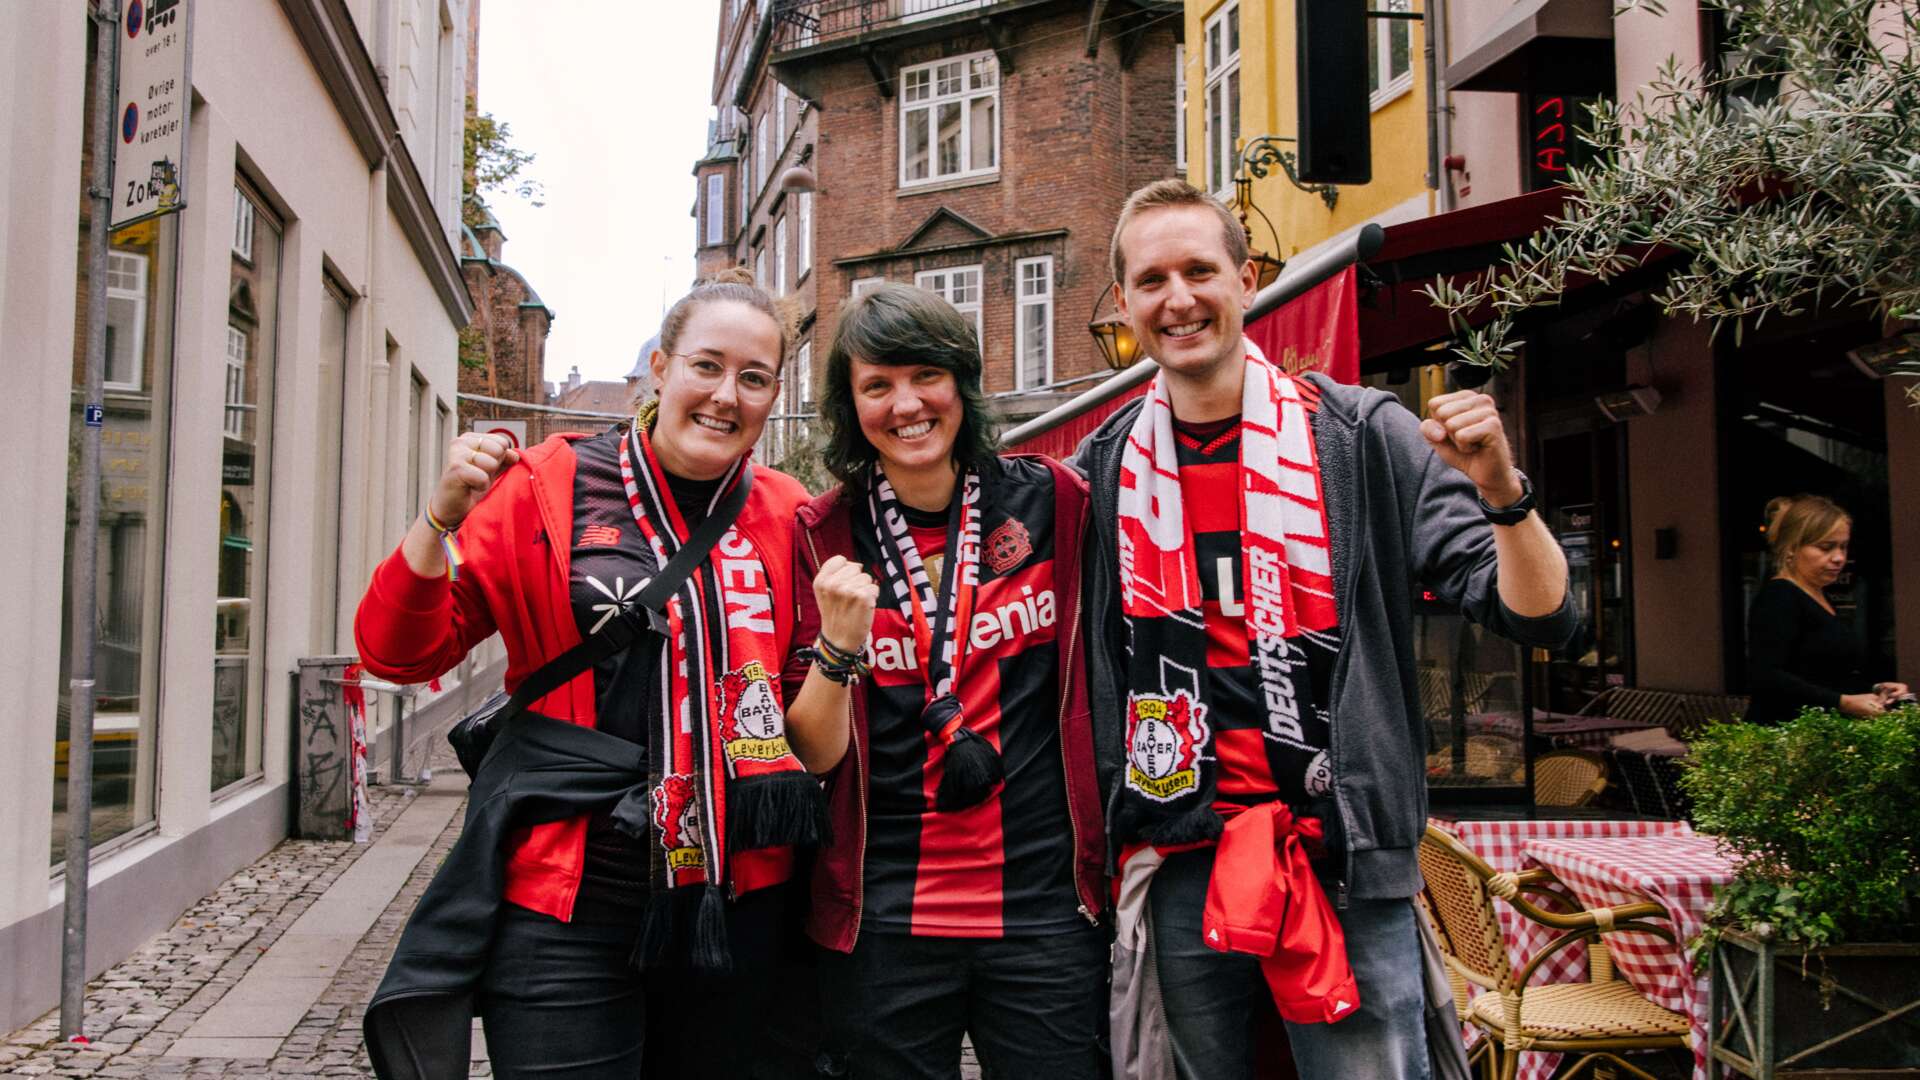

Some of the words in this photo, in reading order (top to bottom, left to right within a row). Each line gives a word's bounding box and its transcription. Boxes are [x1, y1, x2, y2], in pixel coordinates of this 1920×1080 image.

[148, 79, 175, 100] Øvrige
[140, 119, 179, 144] køretøjer
[93, 409, 103, 421] P
[1249, 545, 1305, 743] DEUTSCHER
[759, 683, 775, 736] BAYER
[1147, 721, 1157, 778] BAYER
